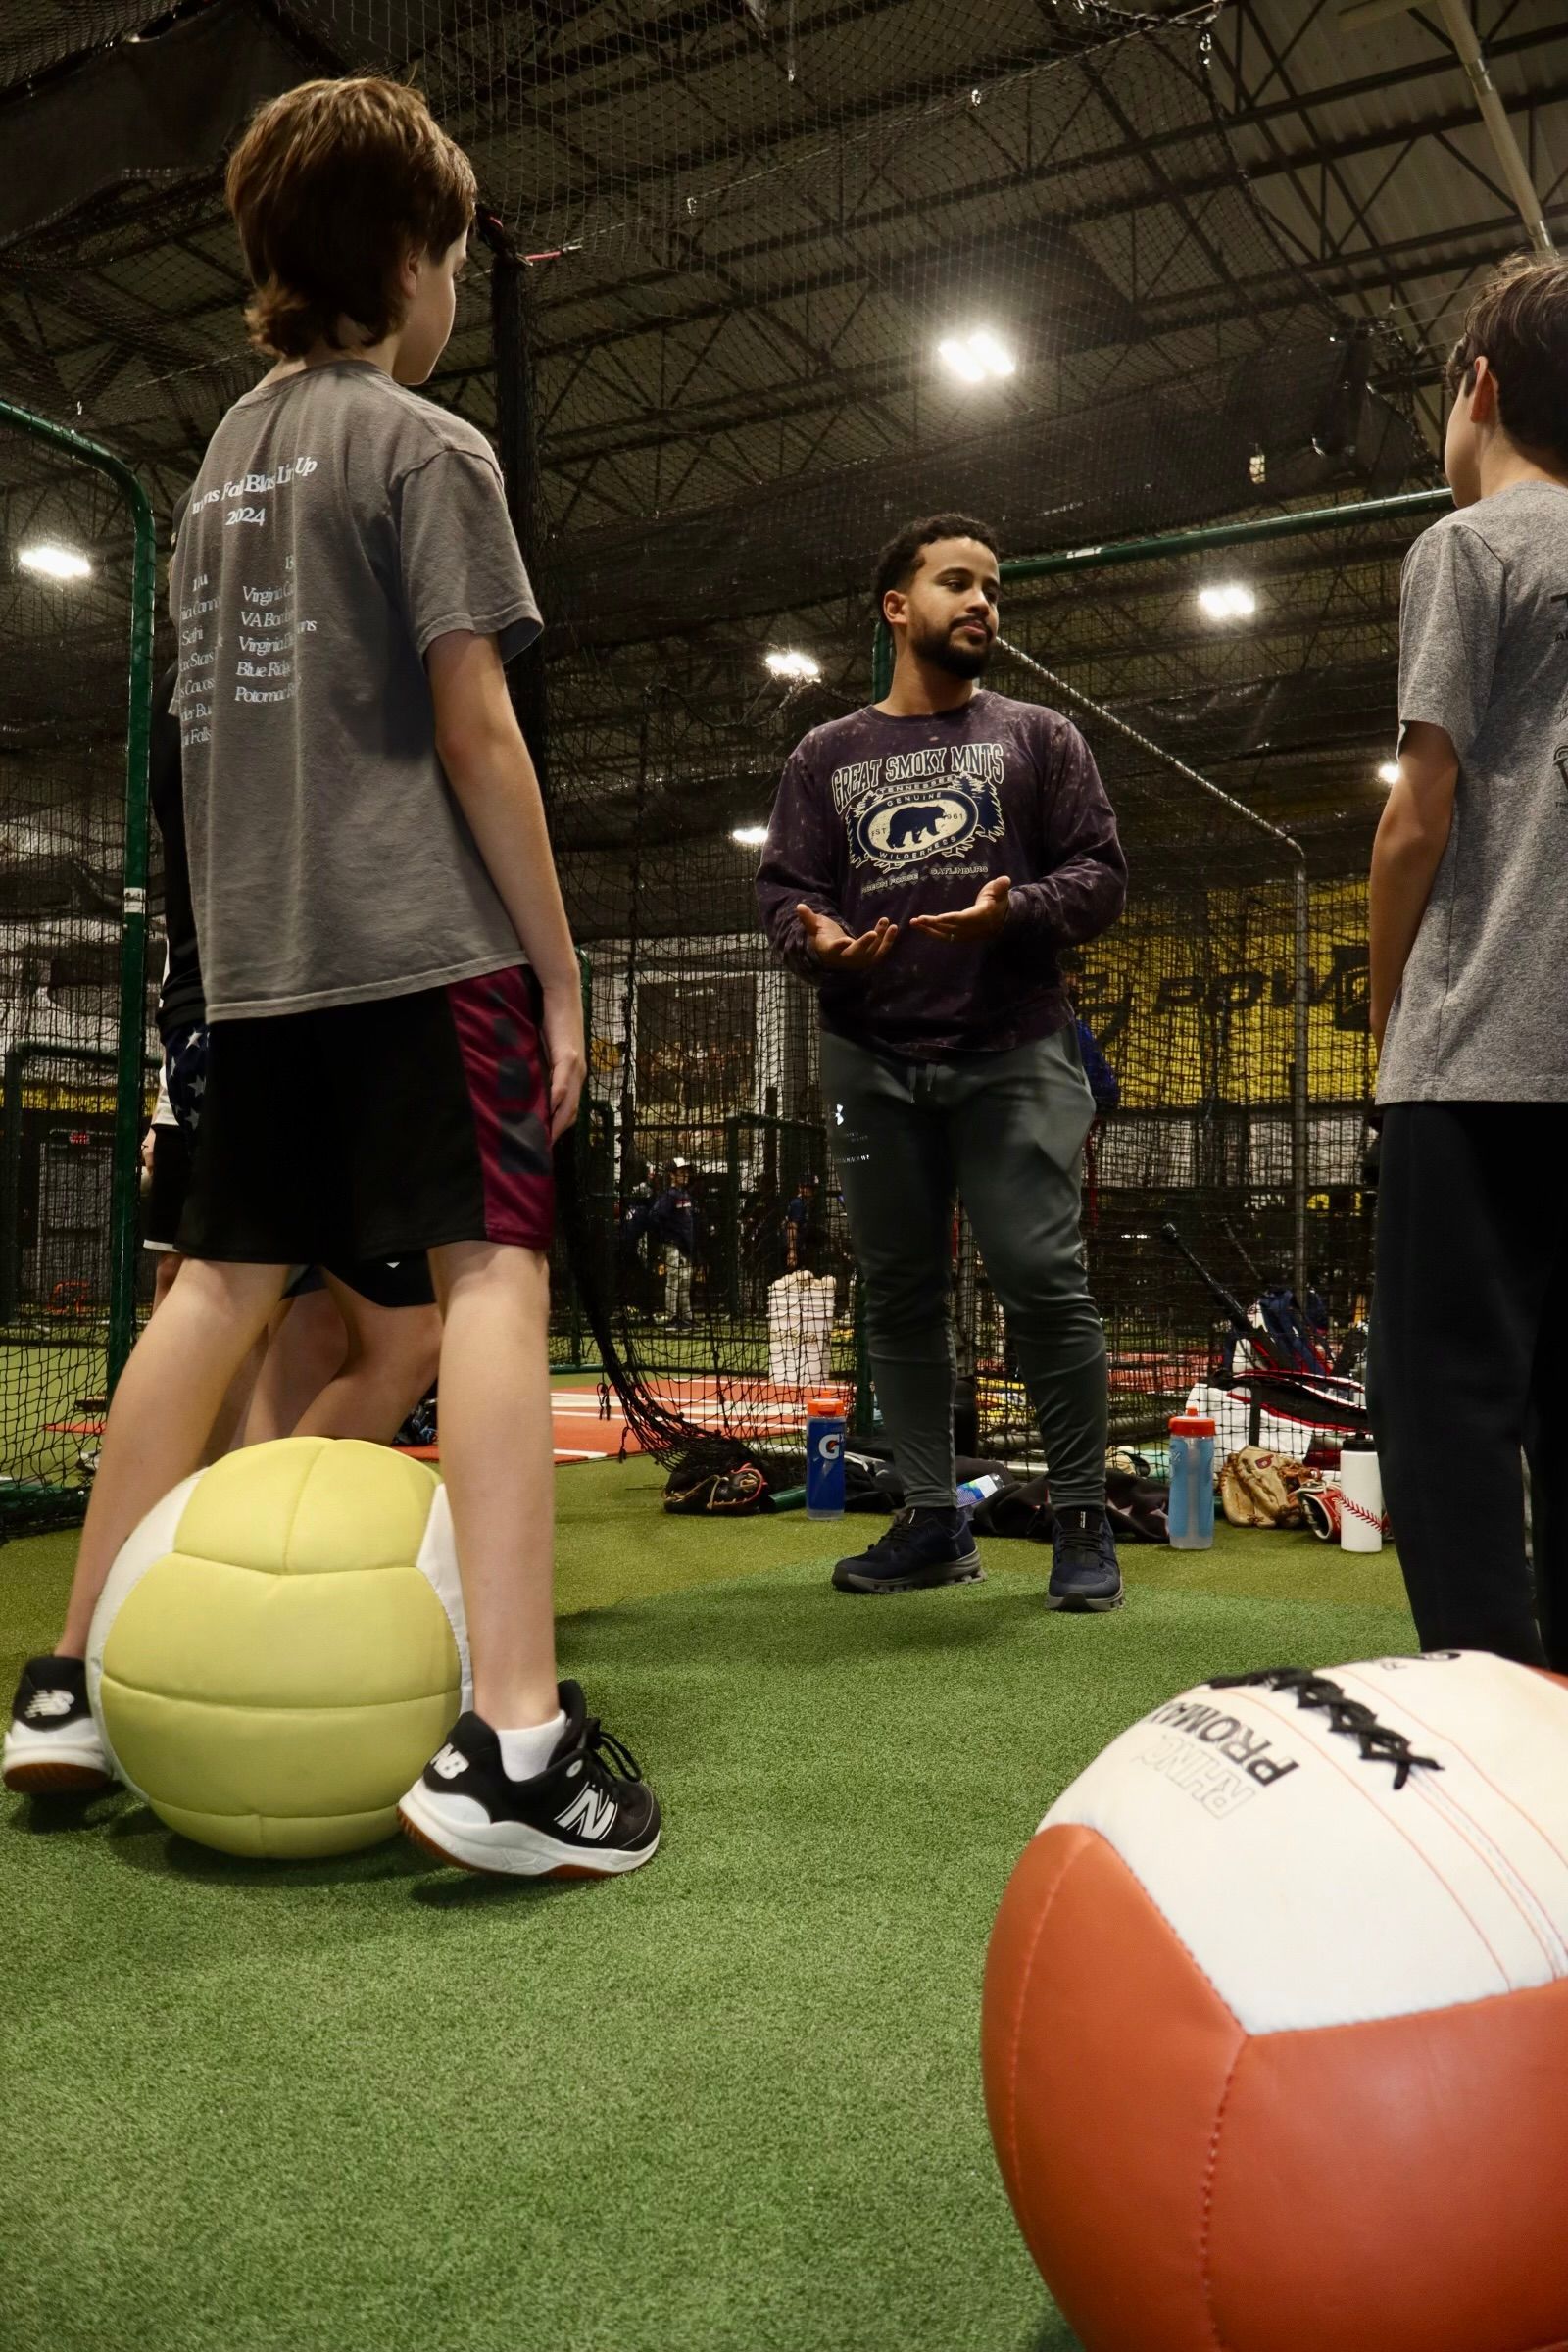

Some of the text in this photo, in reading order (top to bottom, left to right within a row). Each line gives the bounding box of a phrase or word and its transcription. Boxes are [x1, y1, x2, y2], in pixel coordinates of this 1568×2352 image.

[221, 481, 244, 500] Fal
[244, 474, 275, 492] Blas
[295, 457, 318, 476] Up
[225, 507, 266, 526] 2024
[241, 612, 262, 627] VA
[236, 660, 291, 677] Blue Ridg
[235, 686, 288, 702] Potoma
[832, 743, 1004, 814] GREAT SMOKY MNTS
[880, 776, 953, 793] TENNESSEE
[887, 792, 942, 807] GENUINE
[871, 827, 886, 836] EST
[879, 835, 956, 859] WILDERNESS
